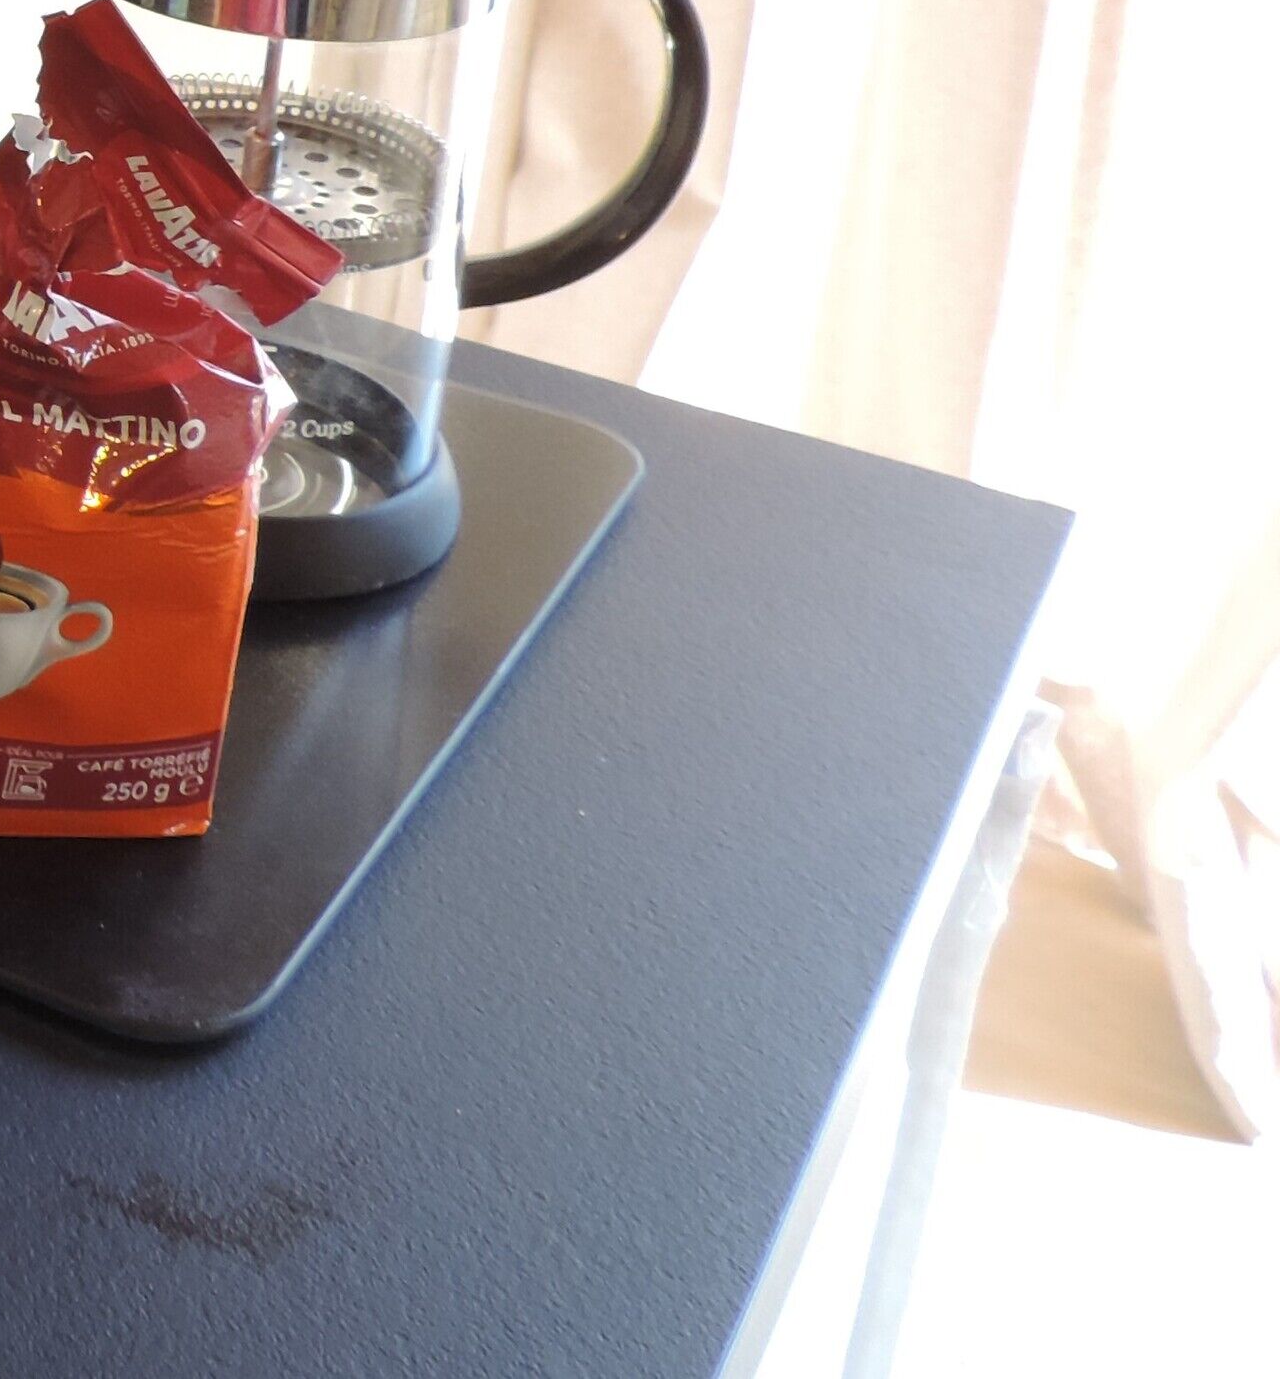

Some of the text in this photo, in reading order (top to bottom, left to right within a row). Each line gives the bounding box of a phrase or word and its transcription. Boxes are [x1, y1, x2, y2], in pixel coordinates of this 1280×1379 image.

[32, 402, 207, 450] MATTINO
[301, 418, 355, 439] Cups
[77, 758, 125, 773] CAFÉ
[149, 762, 209, 780] MOULU
[101, 780, 149, 803] 250
[153, 782, 171, 804] g
